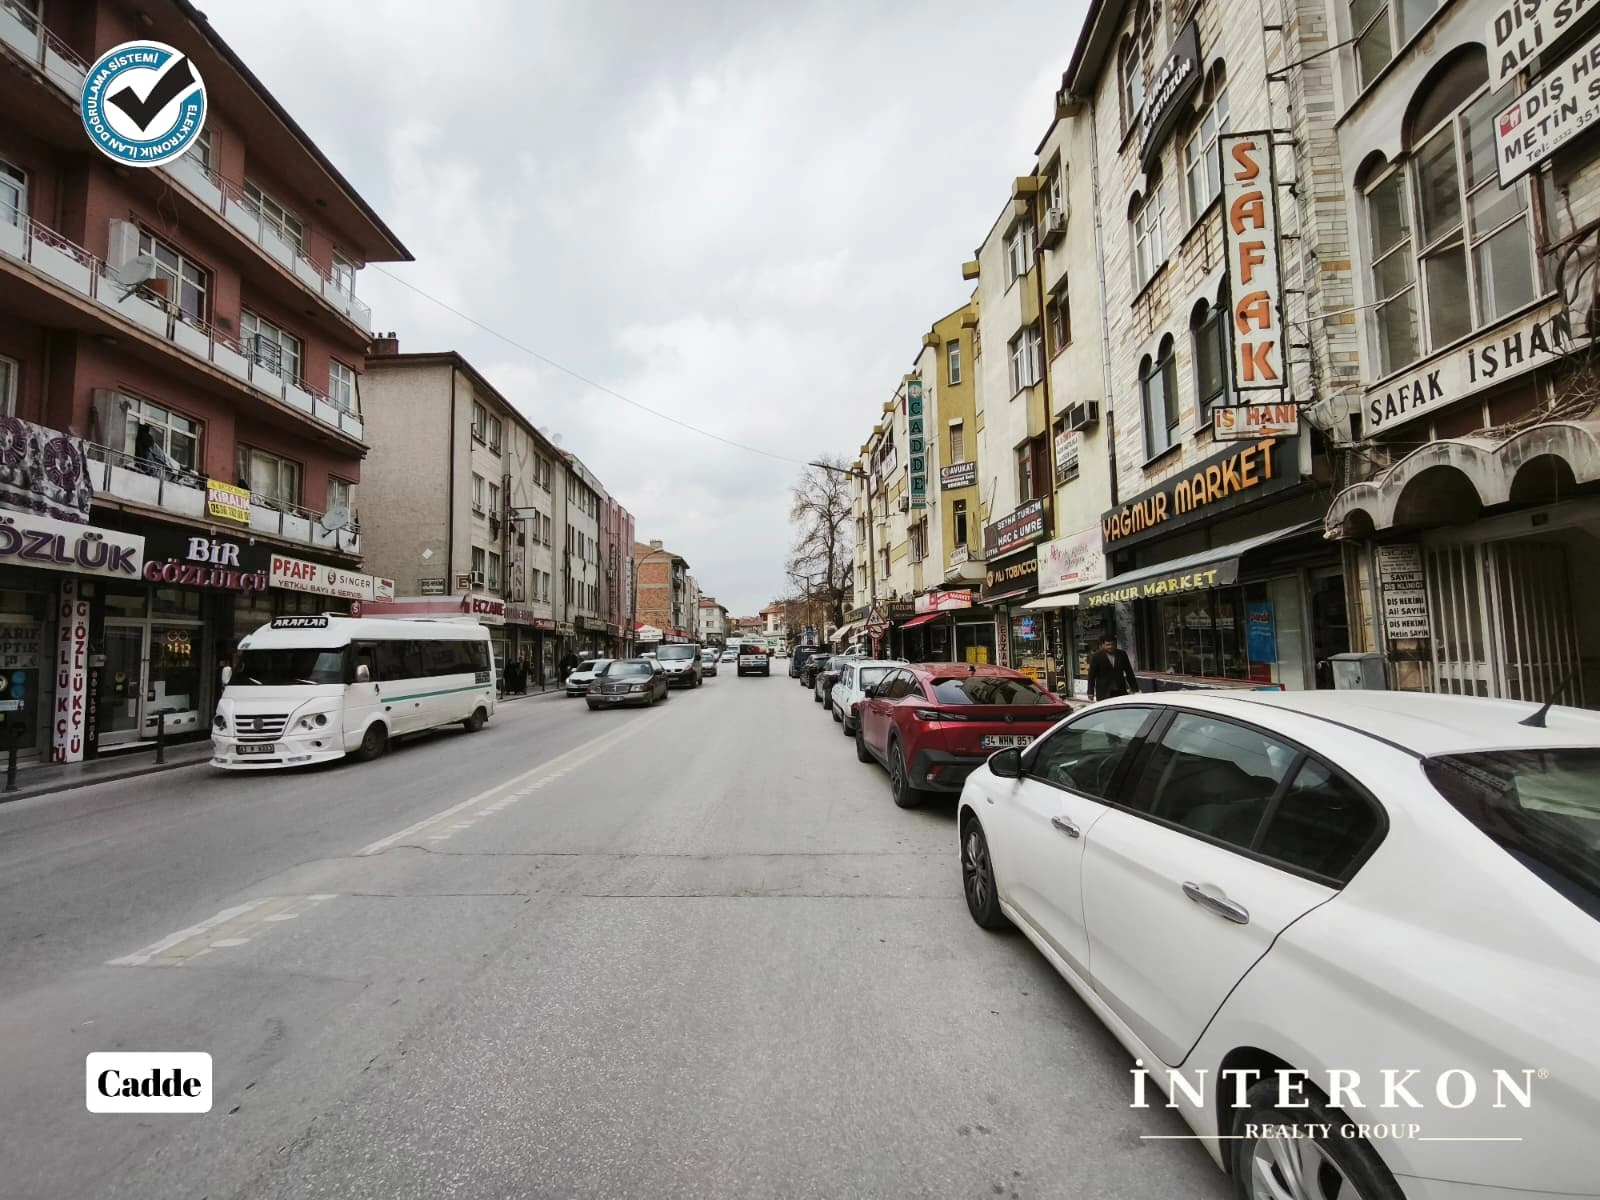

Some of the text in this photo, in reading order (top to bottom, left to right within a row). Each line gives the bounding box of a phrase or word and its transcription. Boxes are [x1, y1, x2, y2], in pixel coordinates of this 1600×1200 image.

[1501, 19, 1544, 79] ALİ
[1526, 76, 1565, 120] DİŞ
[1525, 142, 1549, 163] Tel:
[1229, 141, 1280, 383] ŞAFAK
[1370, 369, 1445, 427] ŞAFAK
[910, 401, 925, 490] CADDE
[950, 463, 974, 475] AVUKAT
[1103, 439, 1276, 543] YAĞMUR MARKET
[998, 532, 1013, 546] HAC
[1019, 518, 1042, 537] UMRE
[143, 557, 268, 593] GÖZLÜKÇÜ
[273, 558, 317, 581] PFAFF
[339, 575, 371, 588] SINGER
[1005, 558, 1037, 580] TOBACCO
[1143, 569, 1218, 597] MARKET
[273, 618, 326, 628] ARAPLAR
[1401, 607, 1426, 615] SAYIN
[70, 602, 87, 754] GÖZLÜKÇÜ
[985, 735, 996, 746] 34
